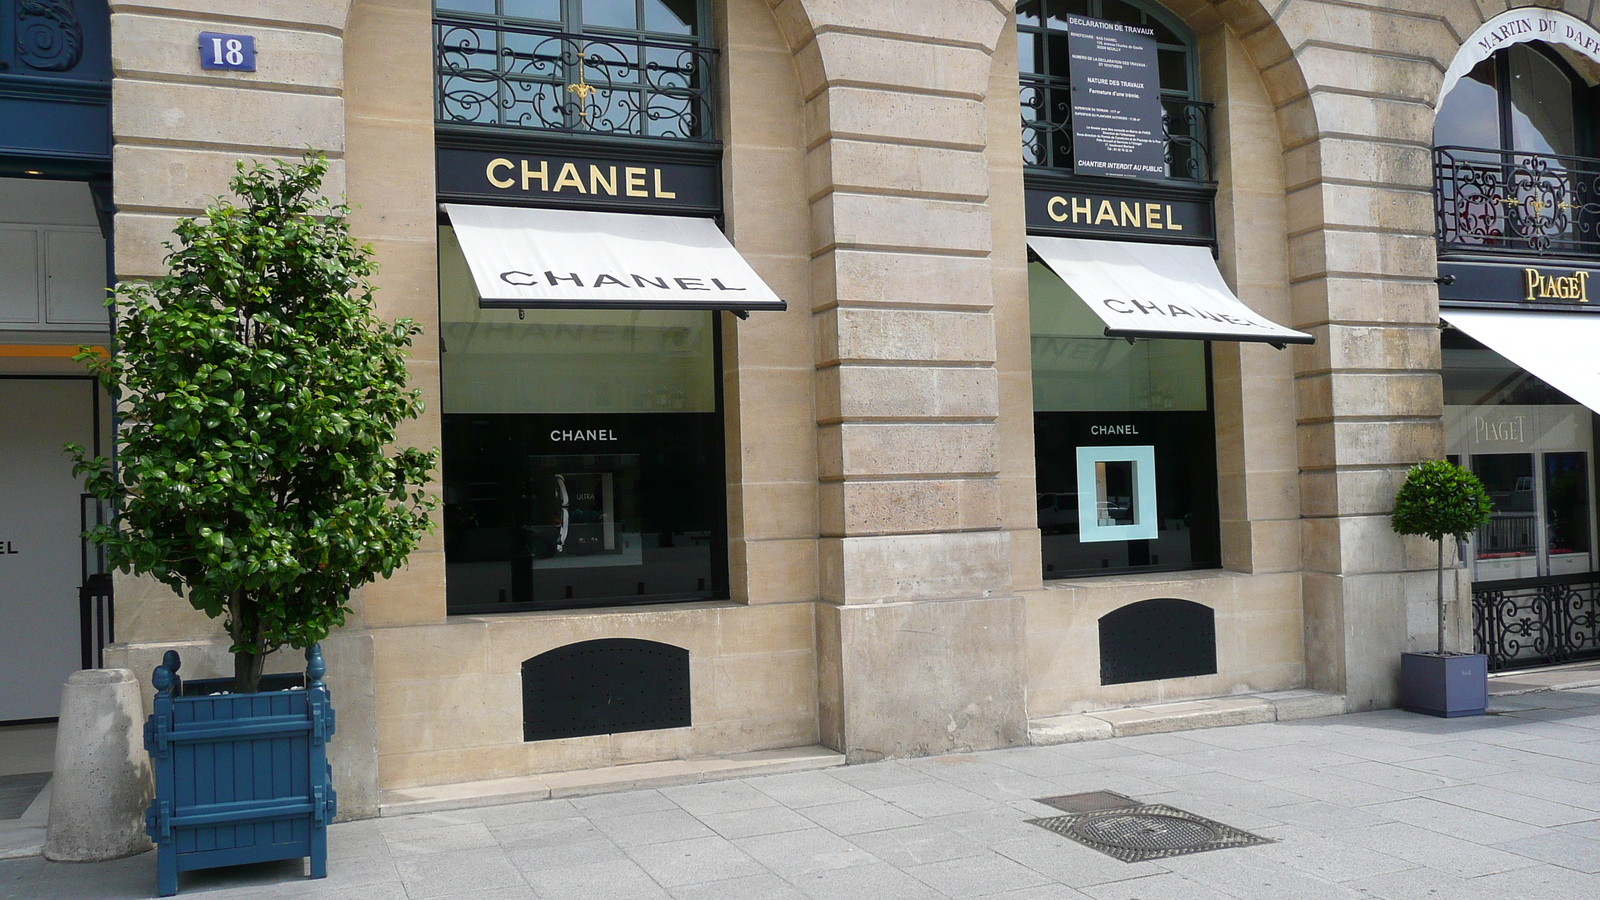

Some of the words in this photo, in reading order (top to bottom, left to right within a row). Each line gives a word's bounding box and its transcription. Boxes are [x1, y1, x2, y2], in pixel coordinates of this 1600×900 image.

[1069, 17, 1113, 30] DECLARATION
[1114, 23, 1124, 32] DE
[1124, 25, 1154, 36] TRAVAUX
[1478, 18, 1532, 54] MARTIN
[1538, 18, 1557, 34] DU
[211, 38, 244, 65] 18
[1087, 77, 1108, 85] NATURE
[1108, 79, 1120, 87] DES
[1120, 80, 1145, 89] TRAVAUX
[486, 157, 676, 199] CHANEL
[1077, 159, 1107, 169] CHANTIER
[1106, 162, 1132, 171] INTERDIT
[1132, 164, 1142, 172] AU
[1142, 165, 1163, 173] PUBLIC
[1047, 196, 1183, 231] CHANEL
[499, 270, 747, 291] CHANEL
[1525, 268, 1589, 302] PIAGET
[1104, 299, 1275, 331] CHANEL
[550, 428, 618, 442] CHANEL
[1091, 424, 1139, 436] CHANEL
[1474, 415, 1526, 444] PIAGET
[576, 492, 596, 501] ULTRA
